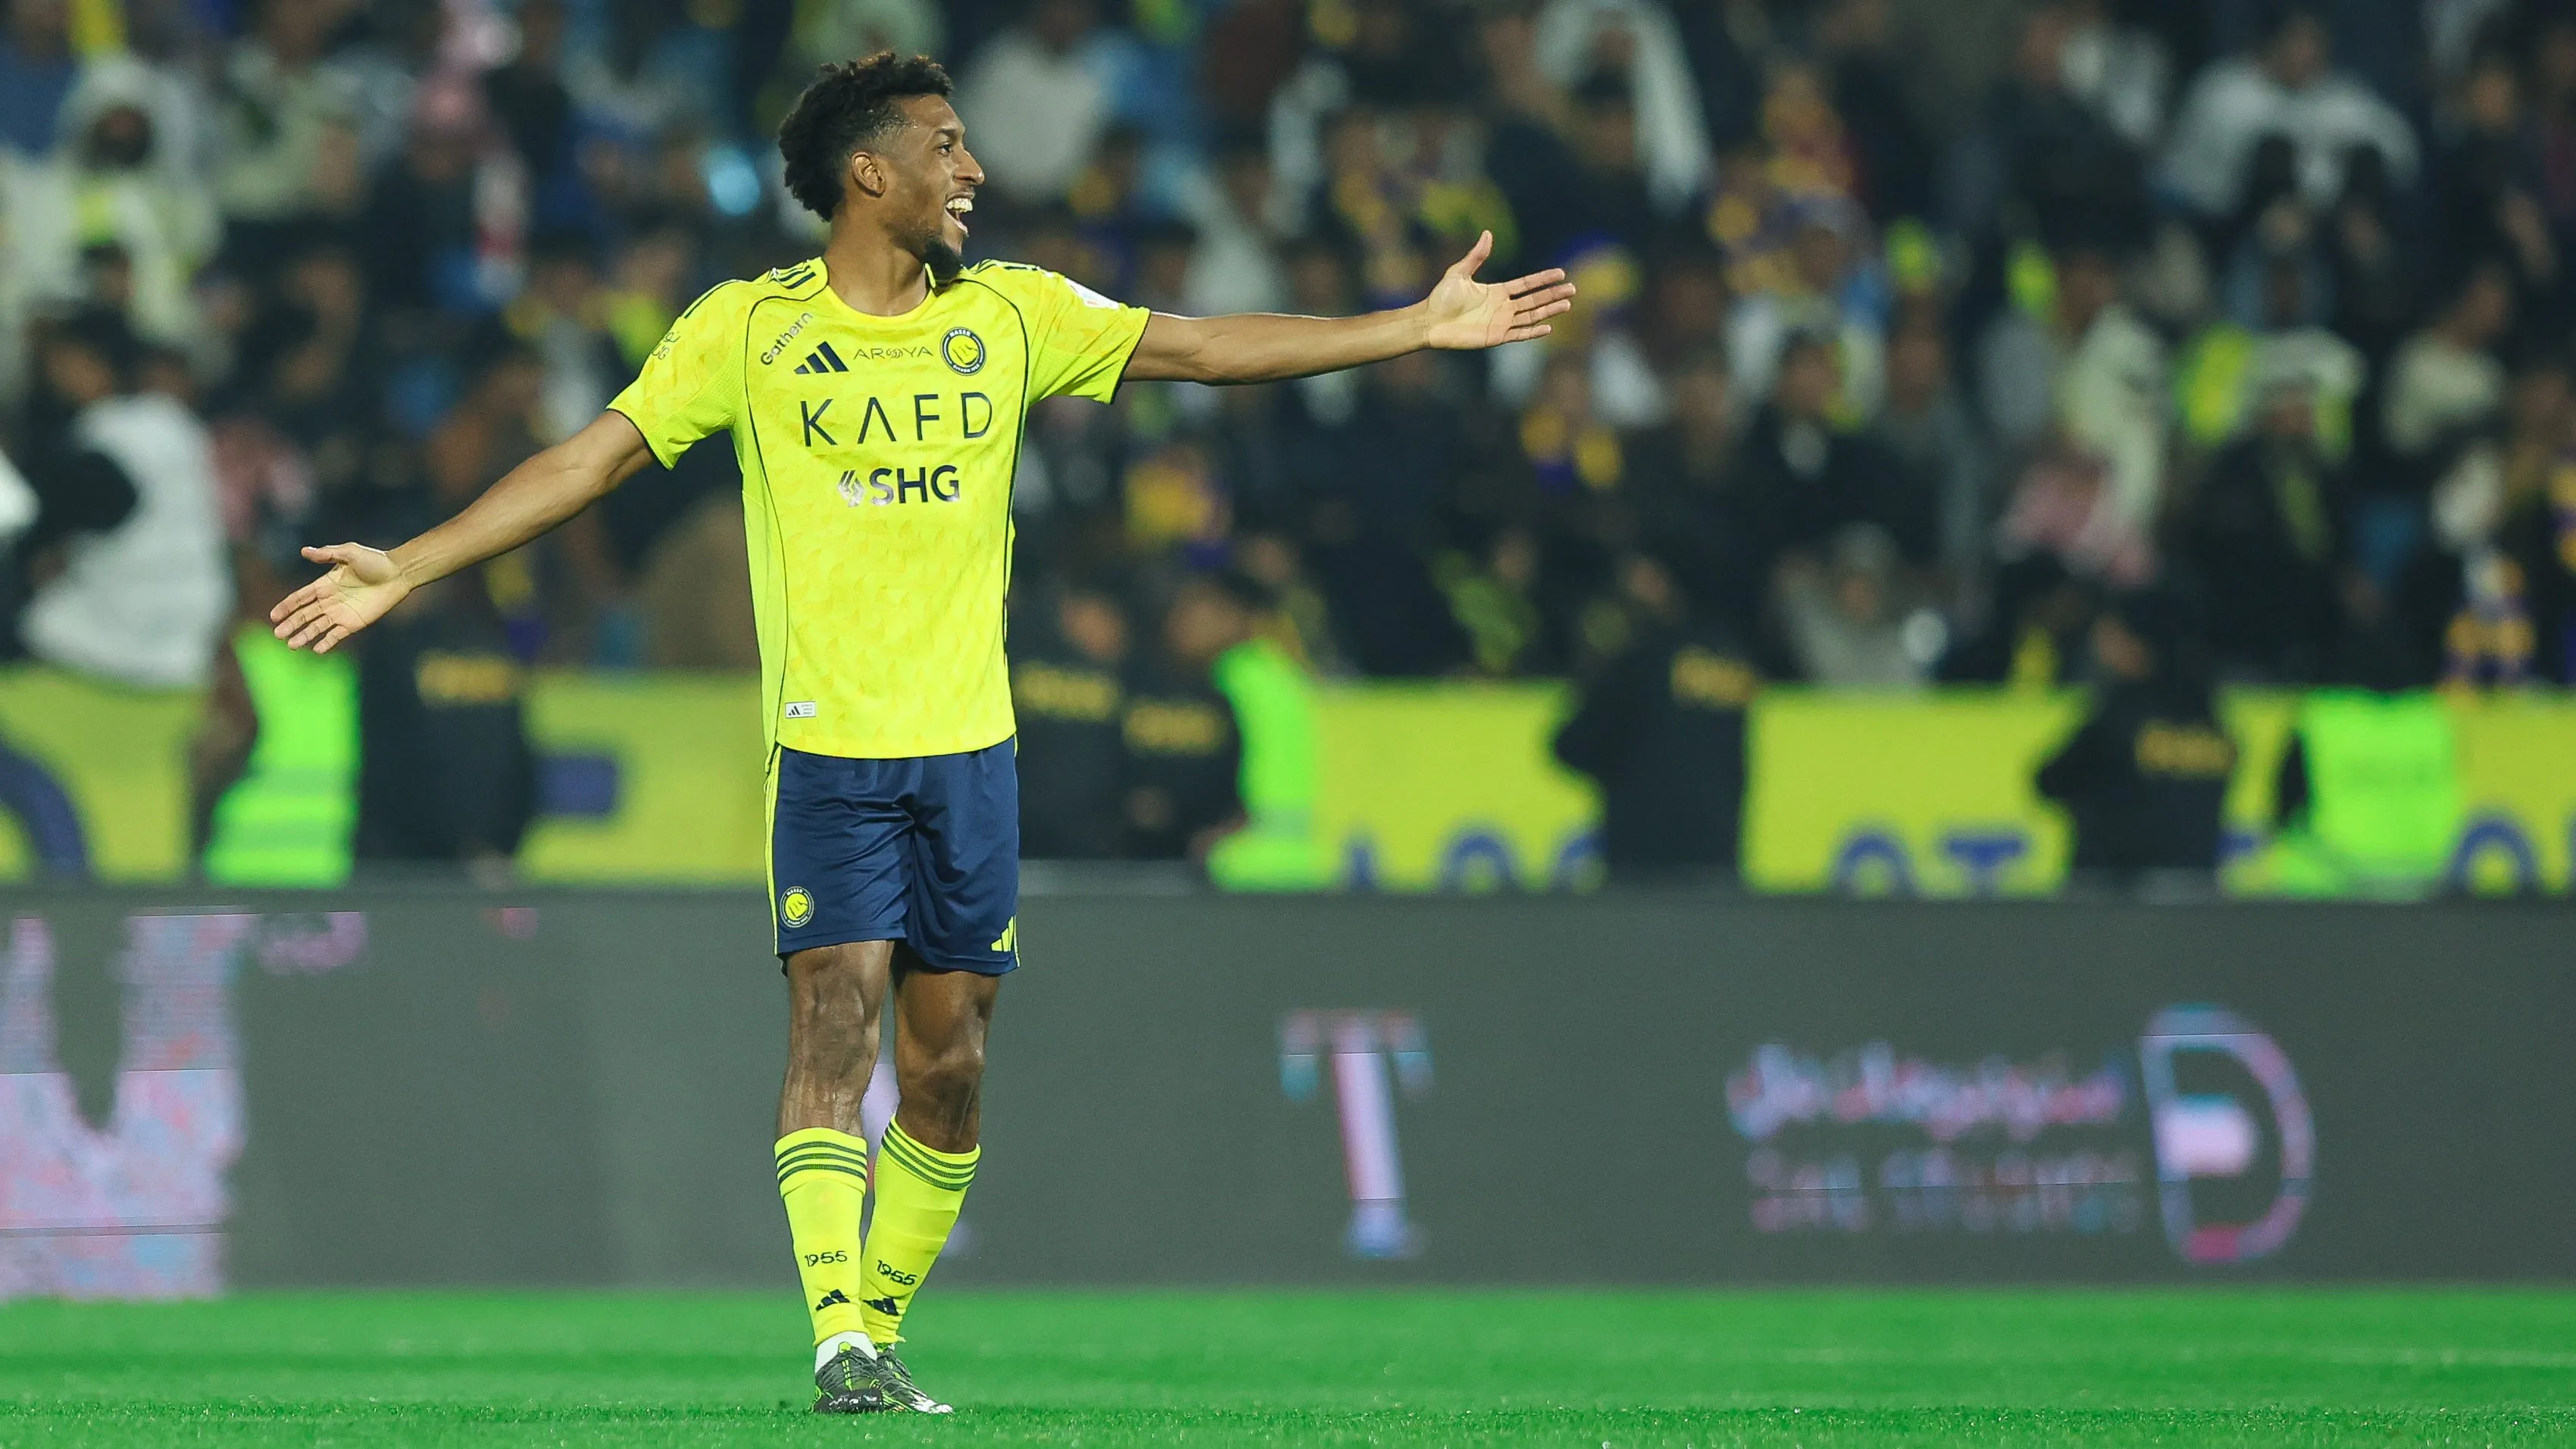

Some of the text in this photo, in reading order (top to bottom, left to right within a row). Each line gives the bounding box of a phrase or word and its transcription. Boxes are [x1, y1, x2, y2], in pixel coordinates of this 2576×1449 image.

[760, 312, 814, 366] Gathern
[800, 391, 993, 448] KAFD
[868, 465, 961, 507] SHG
[804, 1250, 848, 1268] 1955
[877, 1259, 918, 1286] 1955
